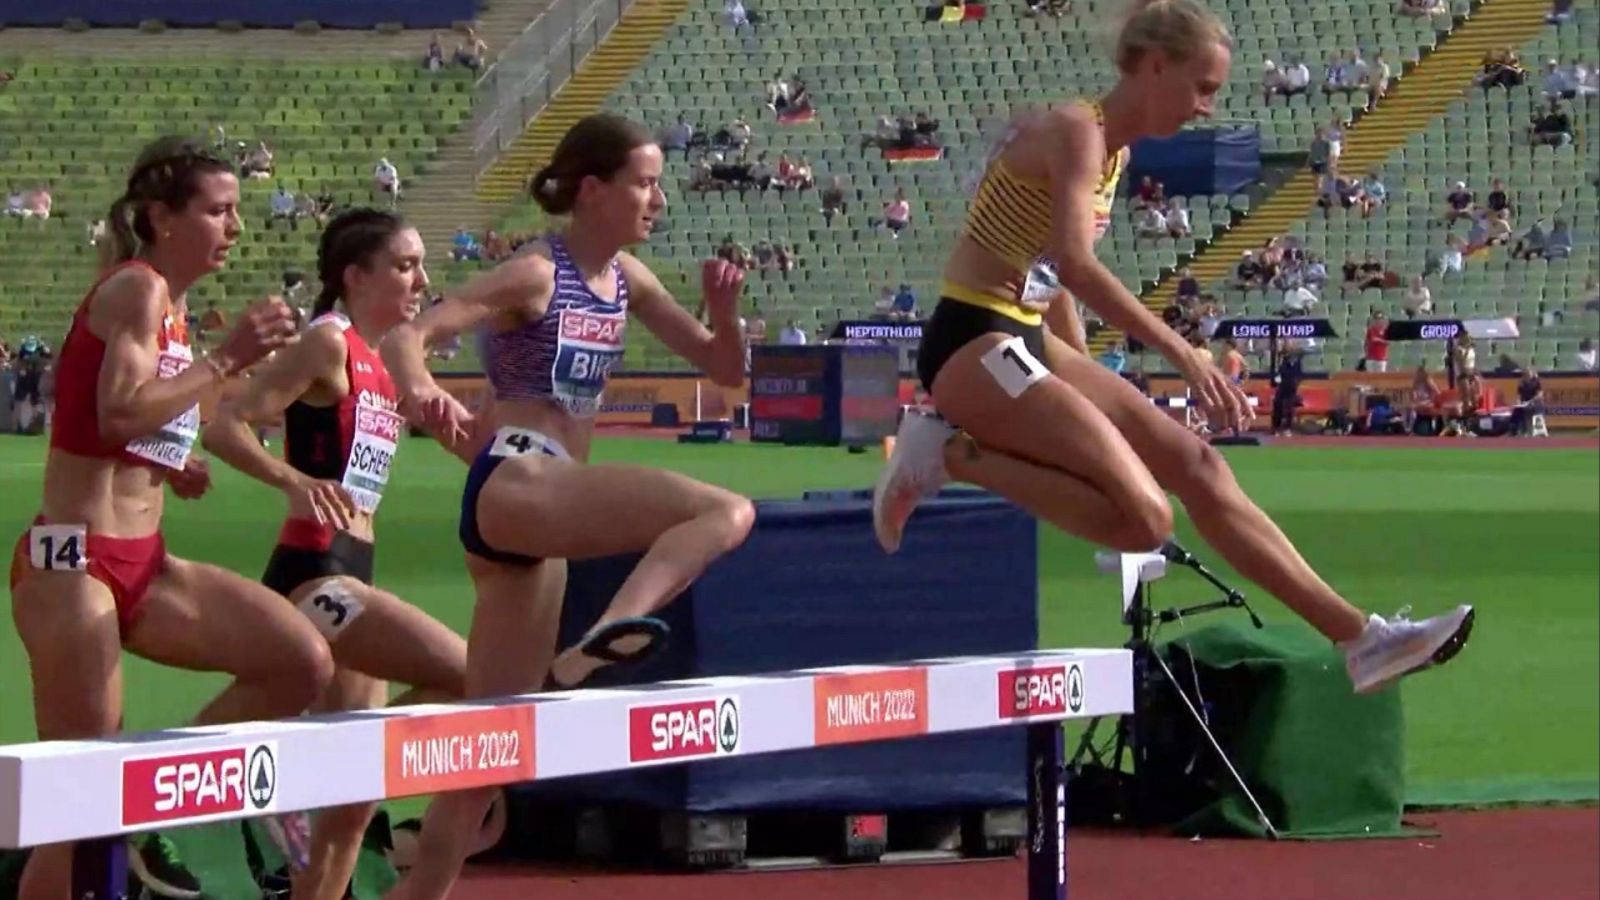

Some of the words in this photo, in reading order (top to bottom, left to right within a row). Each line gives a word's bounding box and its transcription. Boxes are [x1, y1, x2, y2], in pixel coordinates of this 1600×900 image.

[845, 325, 923, 338] HEPTATHLON
[1232, 324, 1269, 337] LONG
[1276, 324, 1315, 336] JUMP
[1420, 325, 1458, 338] GROUP
[1002, 347, 1033, 377] 1
[506, 431, 531, 453] 4
[39, 536, 80, 571] 14
[314, 593, 347, 626] 3
[1014, 672, 1066, 709] SPAR
[826, 693, 880, 727] MUNICH
[883, 689, 916, 720] 2022
[651, 710, 716, 751] SPAR
[402, 738, 472, 777] MUNICH
[477, 731, 520, 769] 2022
[154, 758, 244, 811] SPAR
